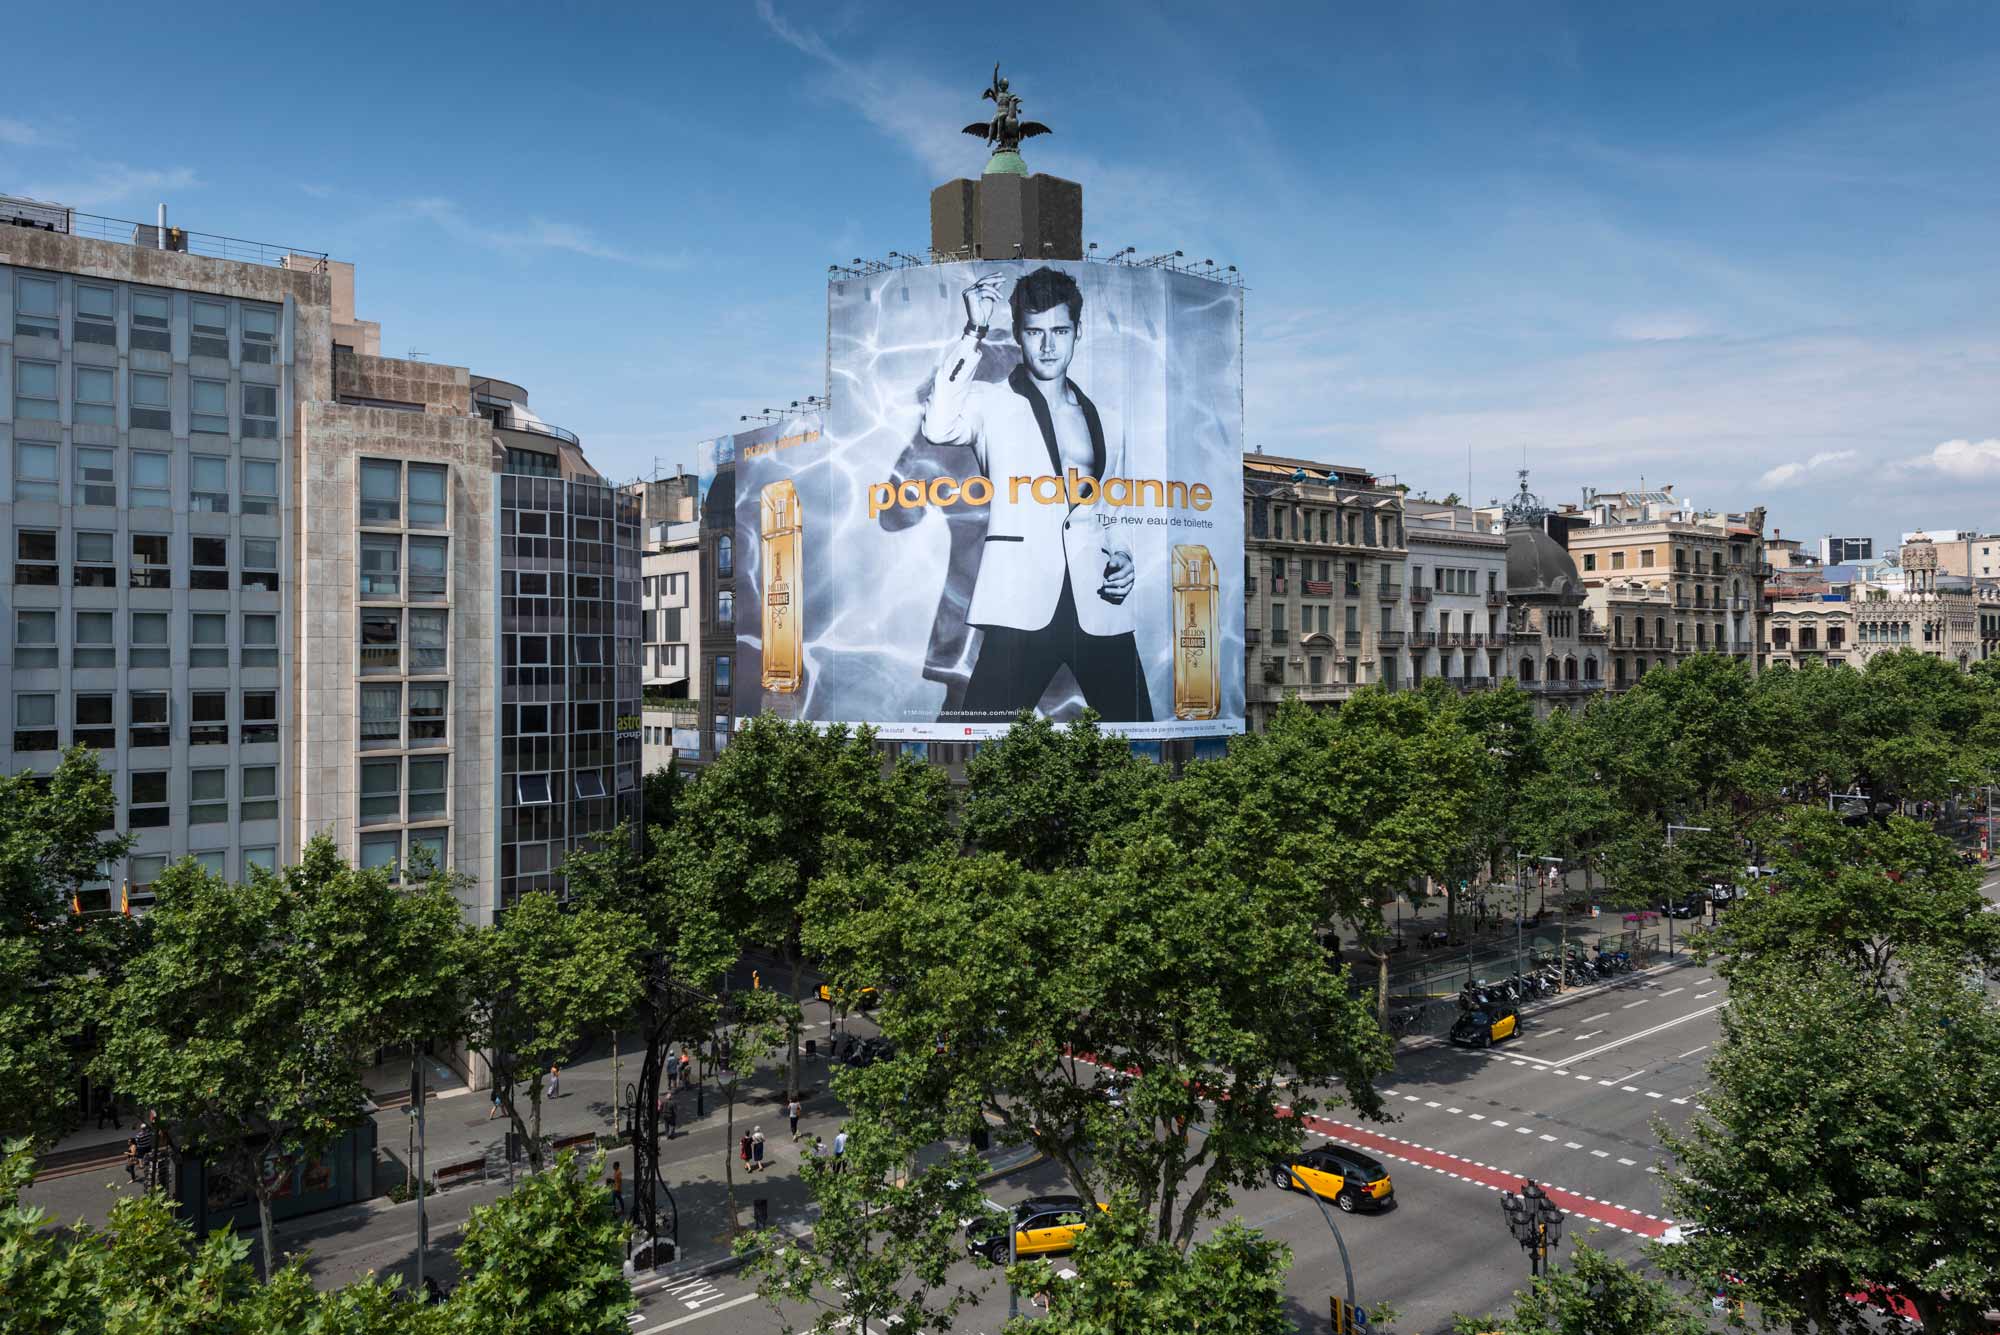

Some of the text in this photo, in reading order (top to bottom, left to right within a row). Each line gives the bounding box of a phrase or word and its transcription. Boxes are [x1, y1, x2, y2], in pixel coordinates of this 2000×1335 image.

[868, 467, 1213, 519] paco rabanne
[1096, 513, 1213, 528] The new eau de toilette
[940, 709, 1031, 717] pacorabanne.com/mil
[661, 1275, 725, 1309] TAXI
